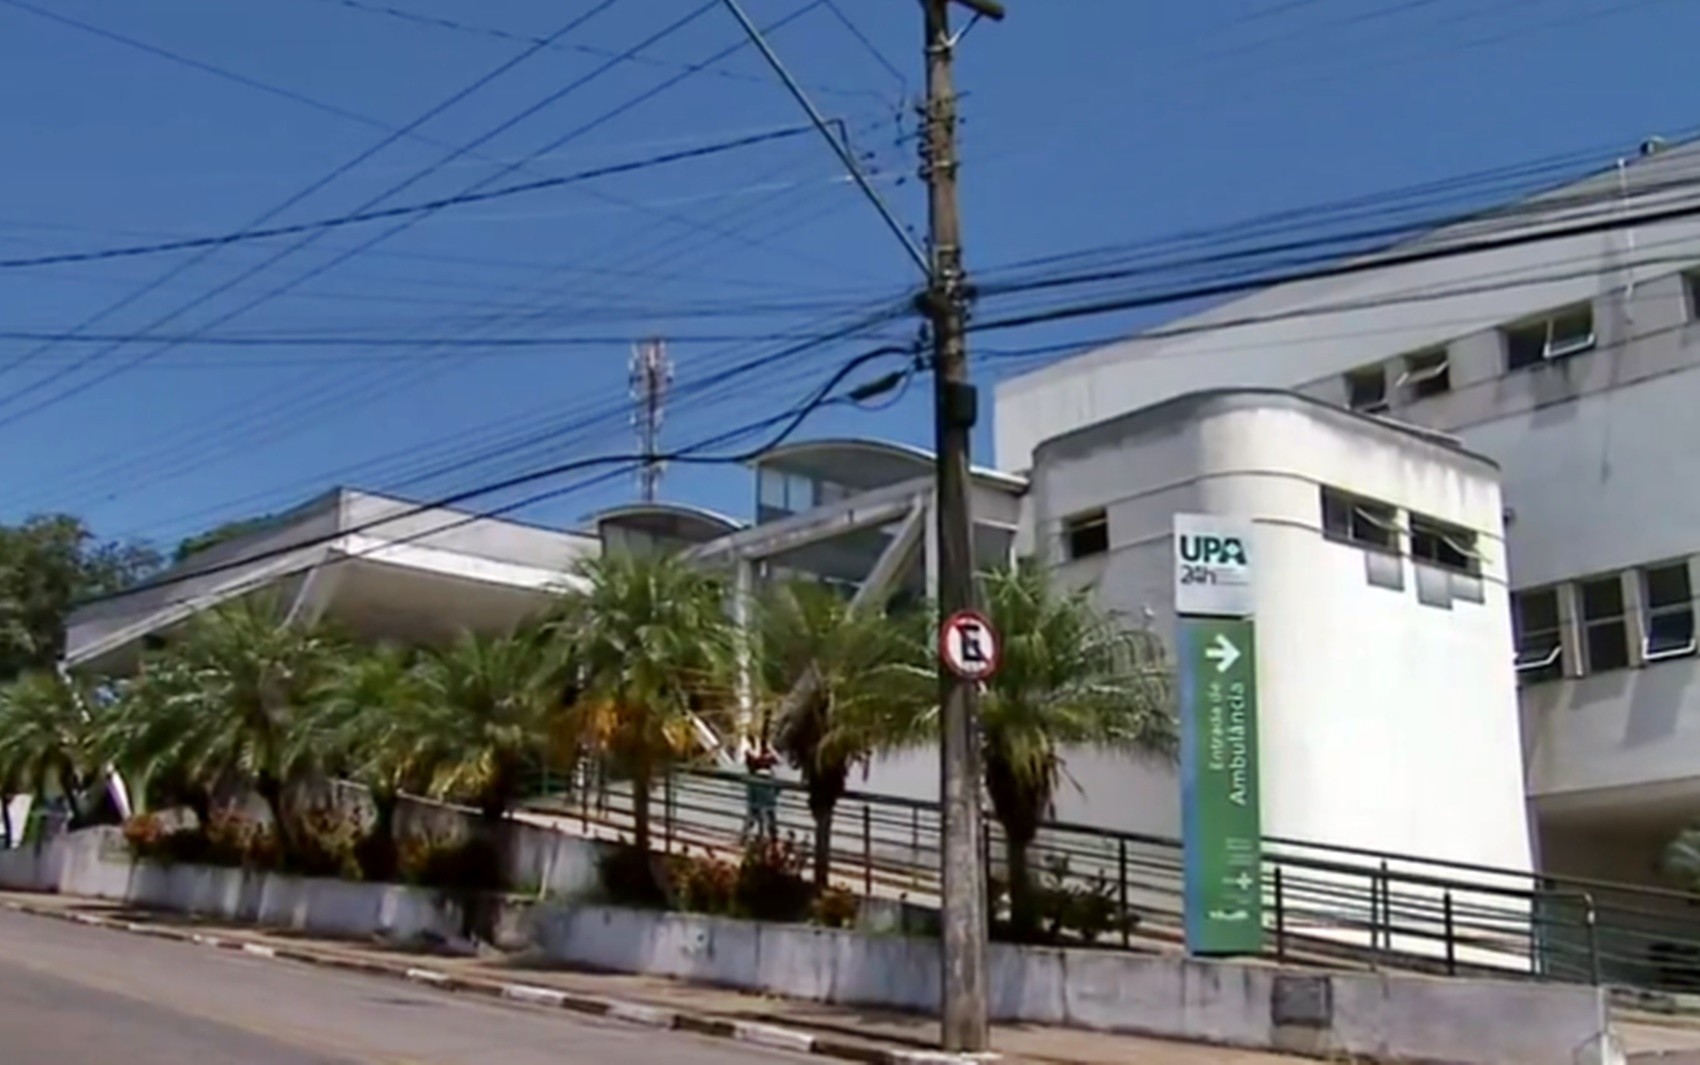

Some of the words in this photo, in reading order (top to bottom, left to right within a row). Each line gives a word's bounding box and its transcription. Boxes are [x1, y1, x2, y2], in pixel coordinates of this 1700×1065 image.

[1180, 535, 1247, 565] UPA
[1181, 564, 1217, 585] 24h
[1208, 707, 1224, 771] Entrada
[1226, 681, 1247, 806] Ambulância
